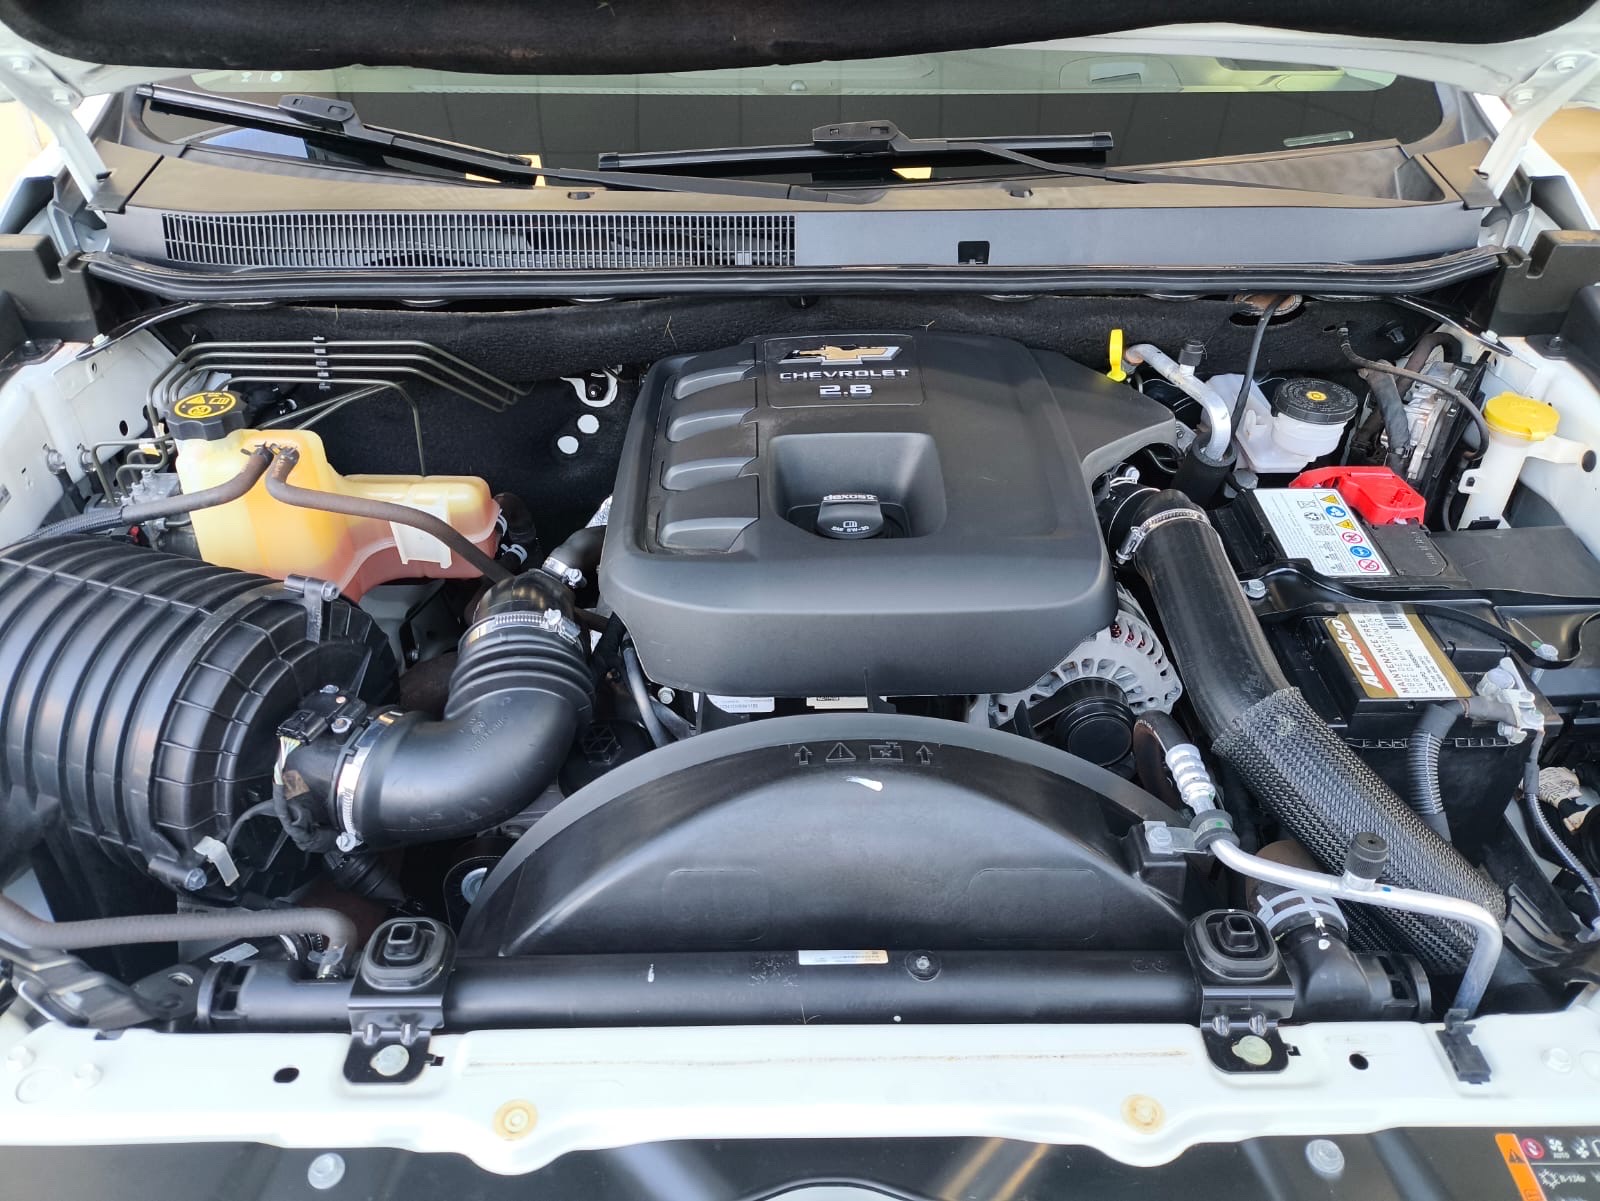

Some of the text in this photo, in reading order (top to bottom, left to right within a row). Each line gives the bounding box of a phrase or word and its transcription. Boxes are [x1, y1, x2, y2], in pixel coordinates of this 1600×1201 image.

[779, 369, 909, 380] CHEVROLET
[819, 384, 873, 395] 2.8
[1331, 619, 1383, 688] ACDelco
[1356, 619, 1410, 693] MAINTENANCE FREE
